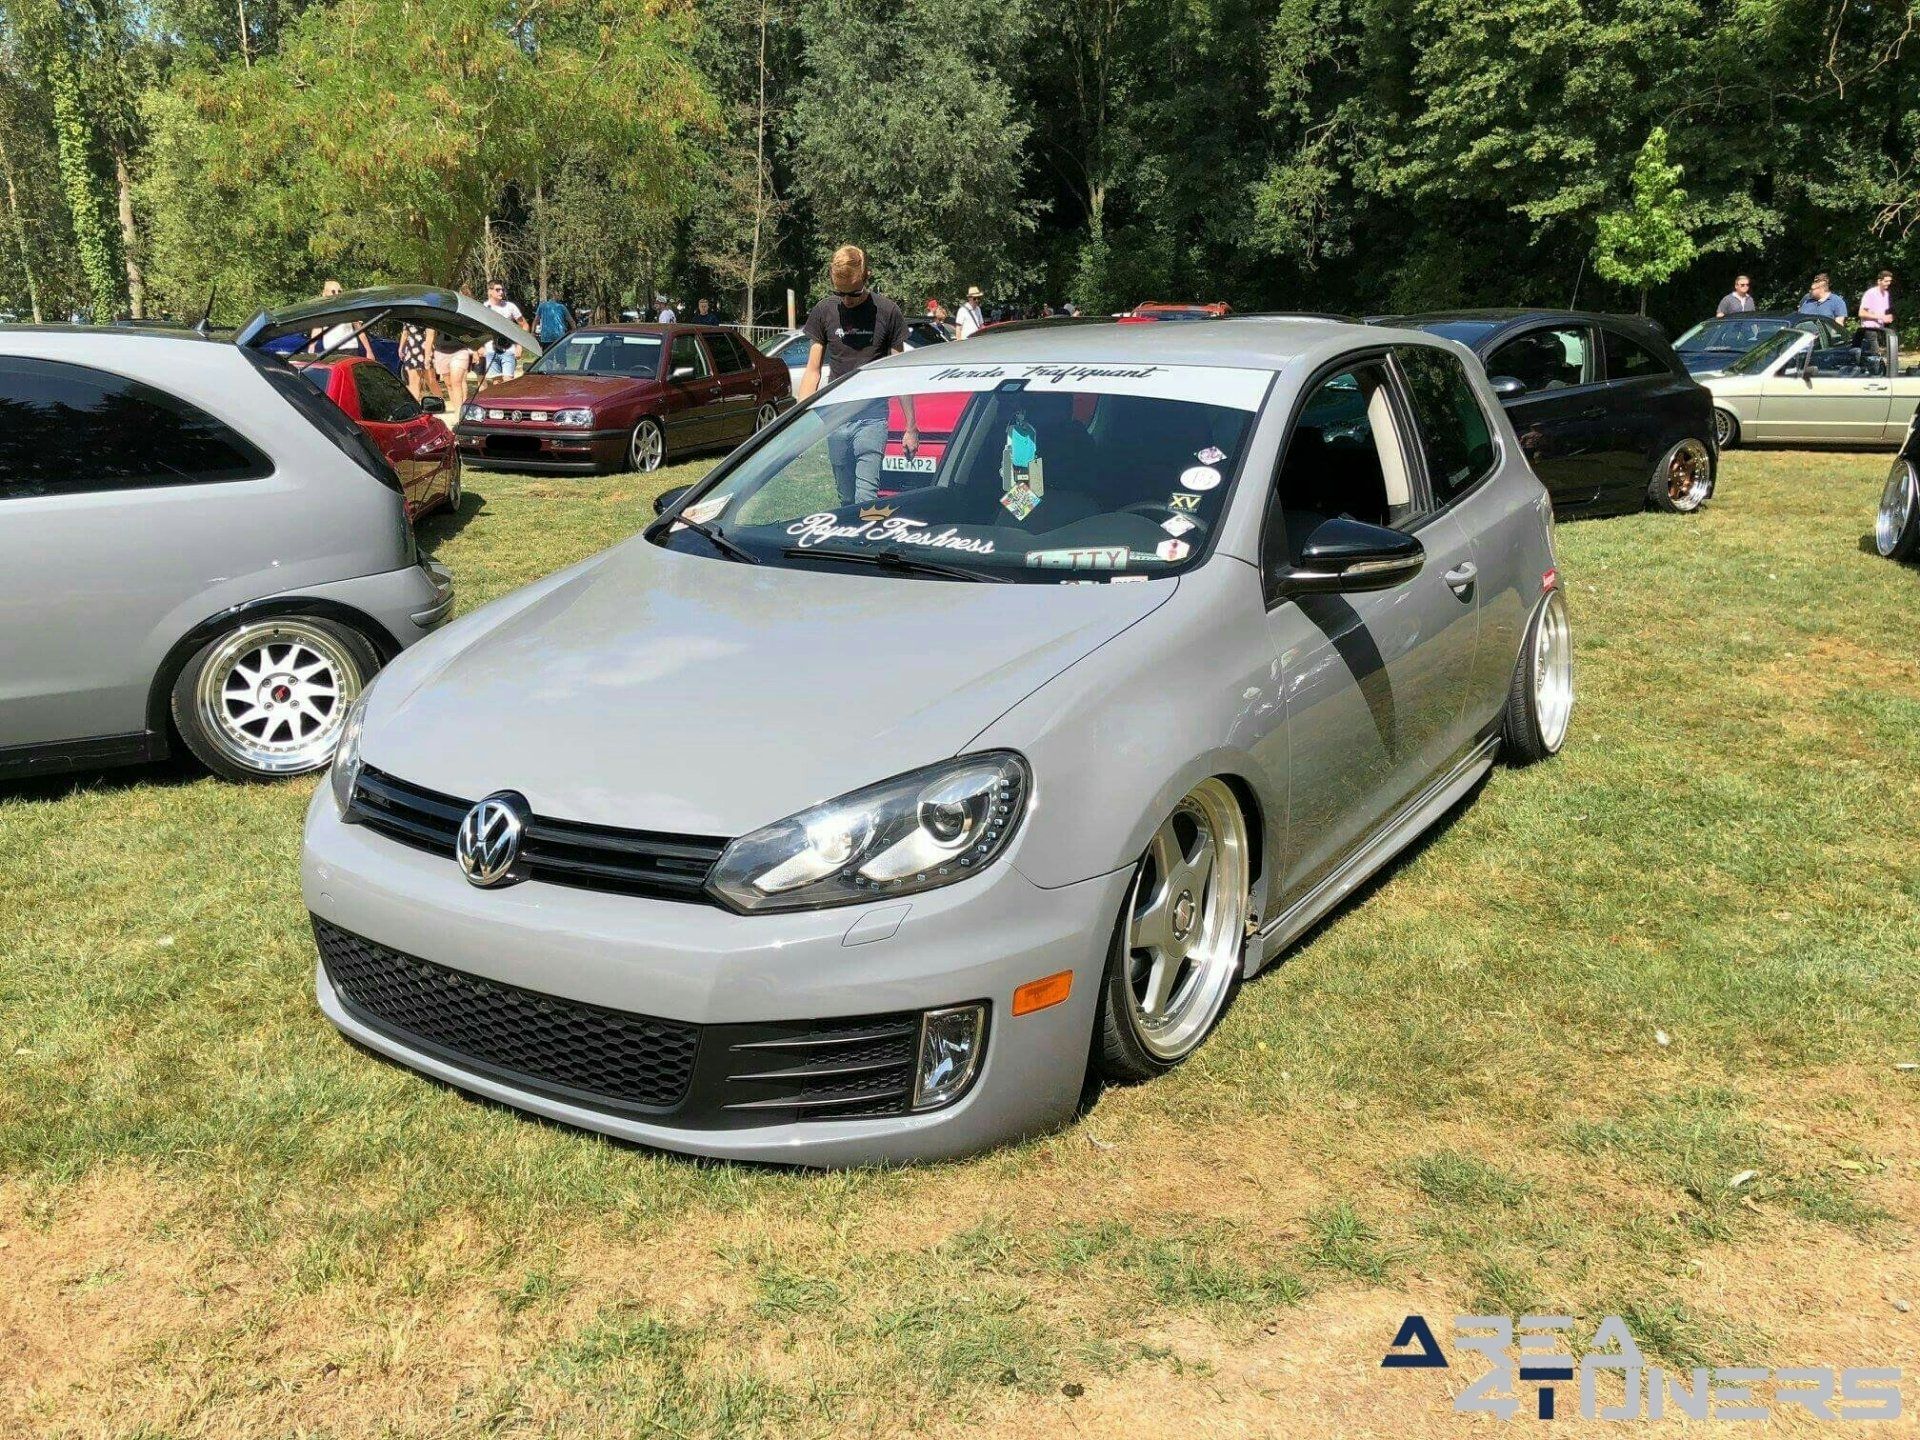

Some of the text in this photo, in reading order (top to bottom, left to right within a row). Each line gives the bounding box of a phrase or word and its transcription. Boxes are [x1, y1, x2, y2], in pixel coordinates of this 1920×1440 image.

[1169, 495, 1201, 508] XV
[786, 512, 996, 554] Royal Freshness
[456, 799, 521, 885] VW
